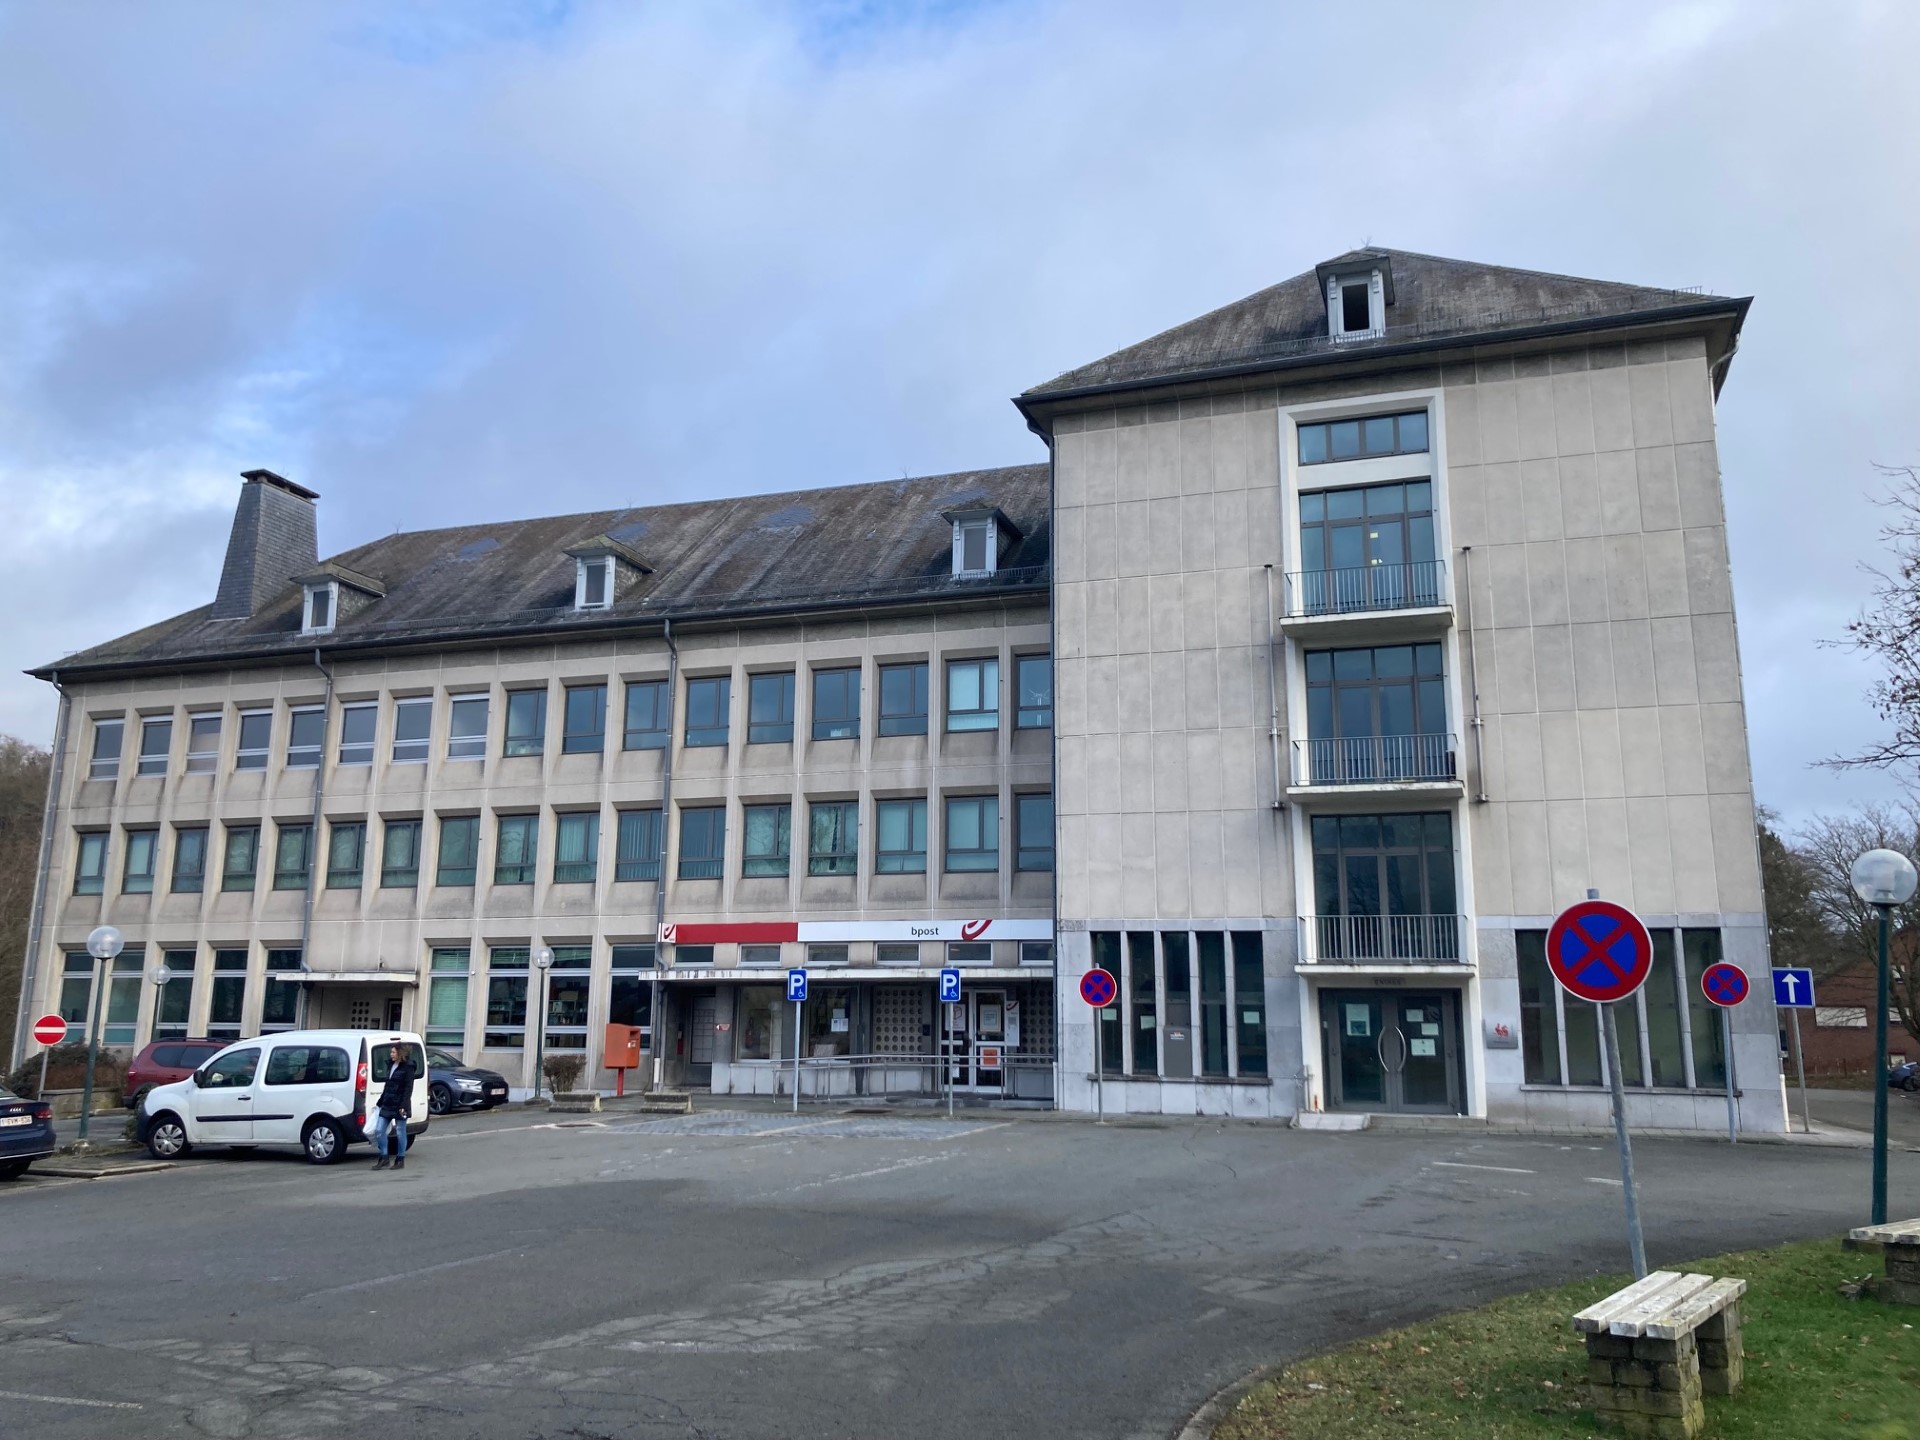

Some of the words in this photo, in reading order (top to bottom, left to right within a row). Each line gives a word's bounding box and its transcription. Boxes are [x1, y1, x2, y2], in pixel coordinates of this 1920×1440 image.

[911, 927, 939, 937] bpost
[791, 974, 804, 995] P
[943, 974, 957, 996] P
